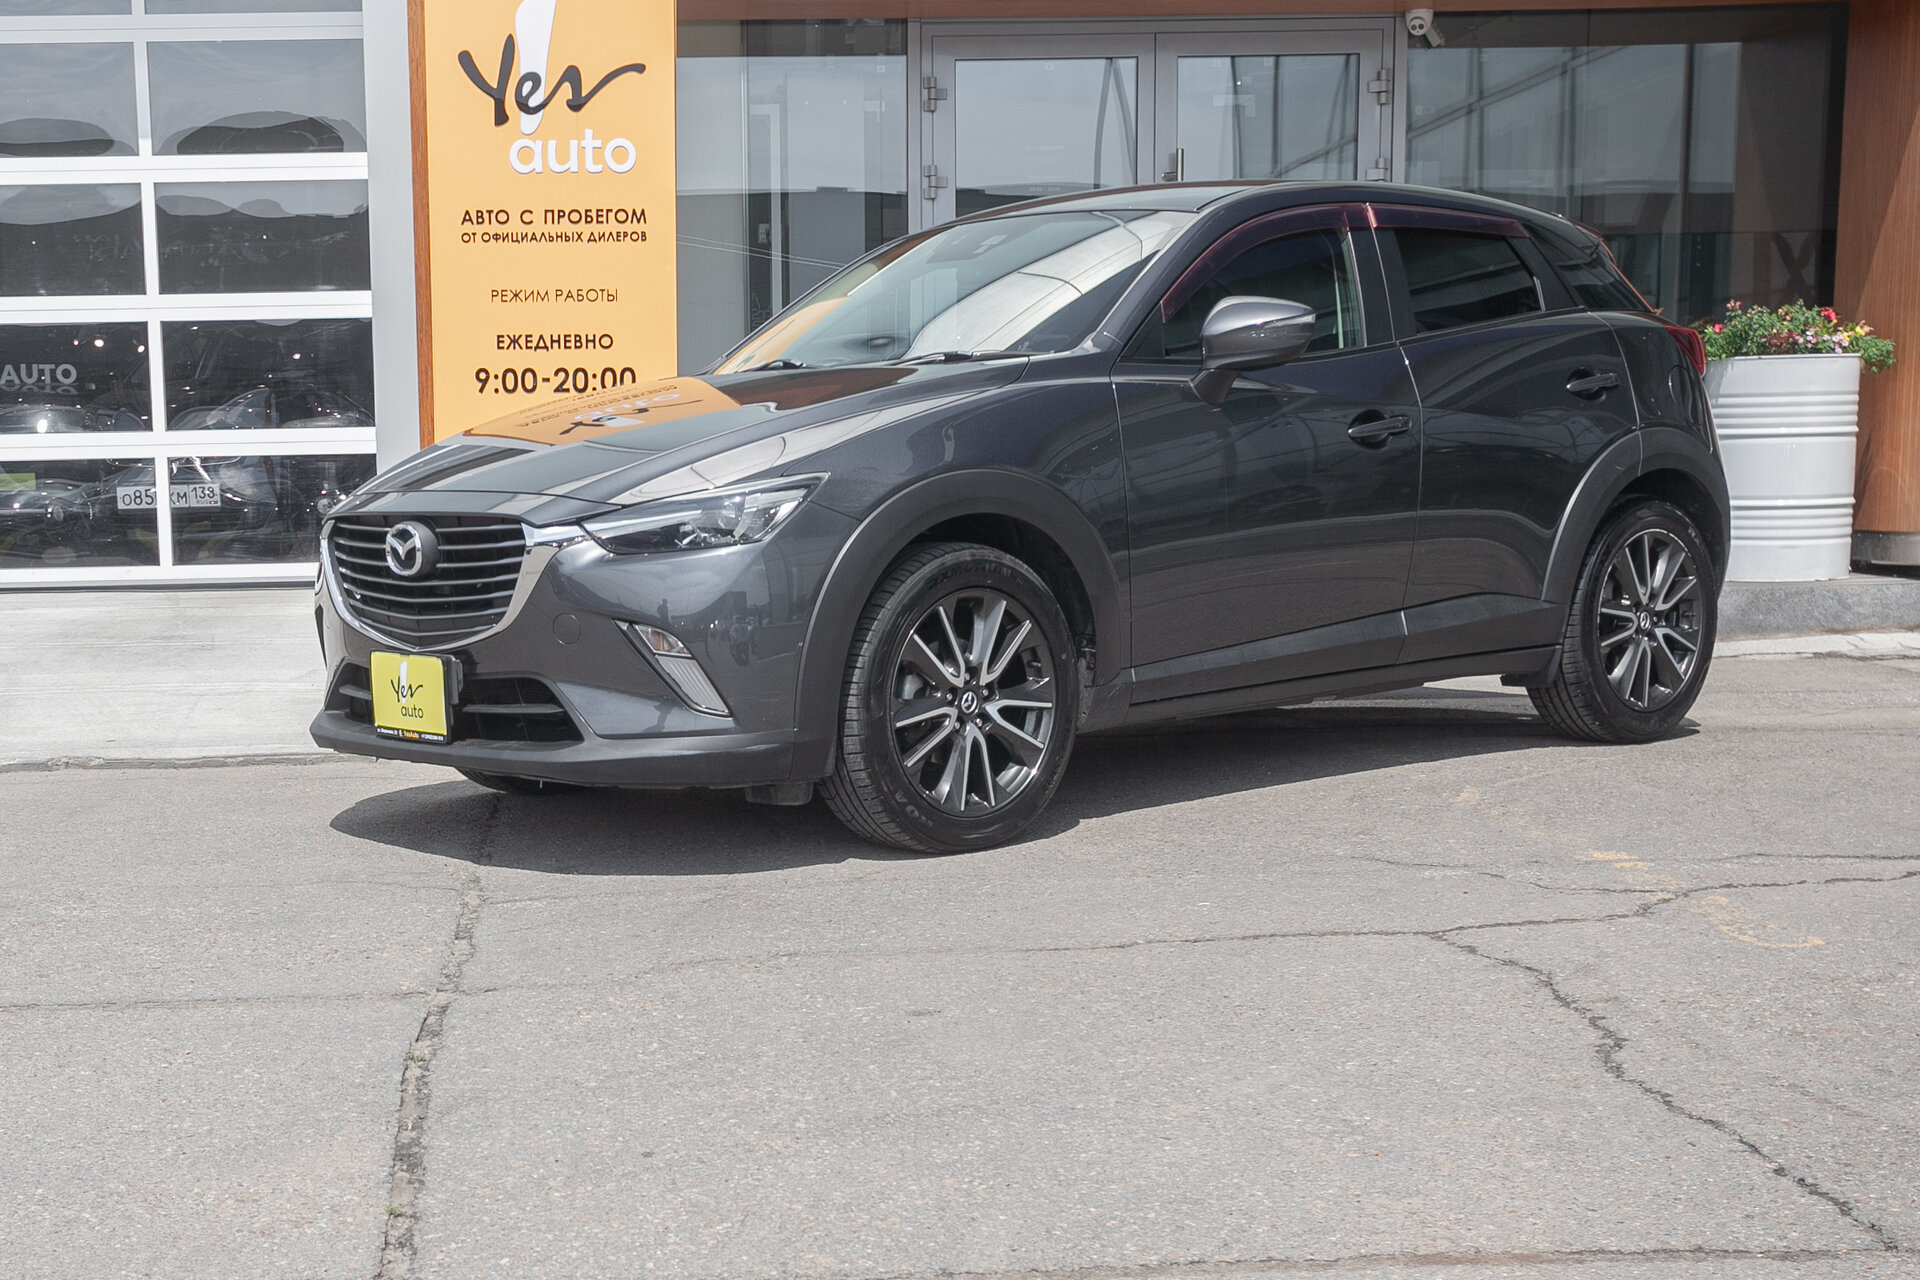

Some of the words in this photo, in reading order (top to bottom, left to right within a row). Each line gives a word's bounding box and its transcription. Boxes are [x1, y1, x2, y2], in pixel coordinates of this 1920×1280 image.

[457, 33, 646, 127] Yes
[509, 129, 636, 174] auto
[461, 209, 510, 226] АВТО
[519, 209, 534, 225] С
[543, 208, 647, 226] ПРОБЕГОМ
[461, 231, 476, 244] ОТ
[480, 230, 584, 245] ОФИЦИАЛЬНЫХ
[587, 230, 647, 244] ДИЛЕРОВ
[490, 288, 550, 304] РЕЖИМ
[554, 287, 618, 303] РАБОТЫ
[496, 333, 614, 352] ЕЖЕДНЕВНО
[0, 363, 77, 385] AUTO
[475, 366, 637, 394] 9:00-20:00
[390, 676, 424, 703] Yes
[400, 705, 424, 719] auto
